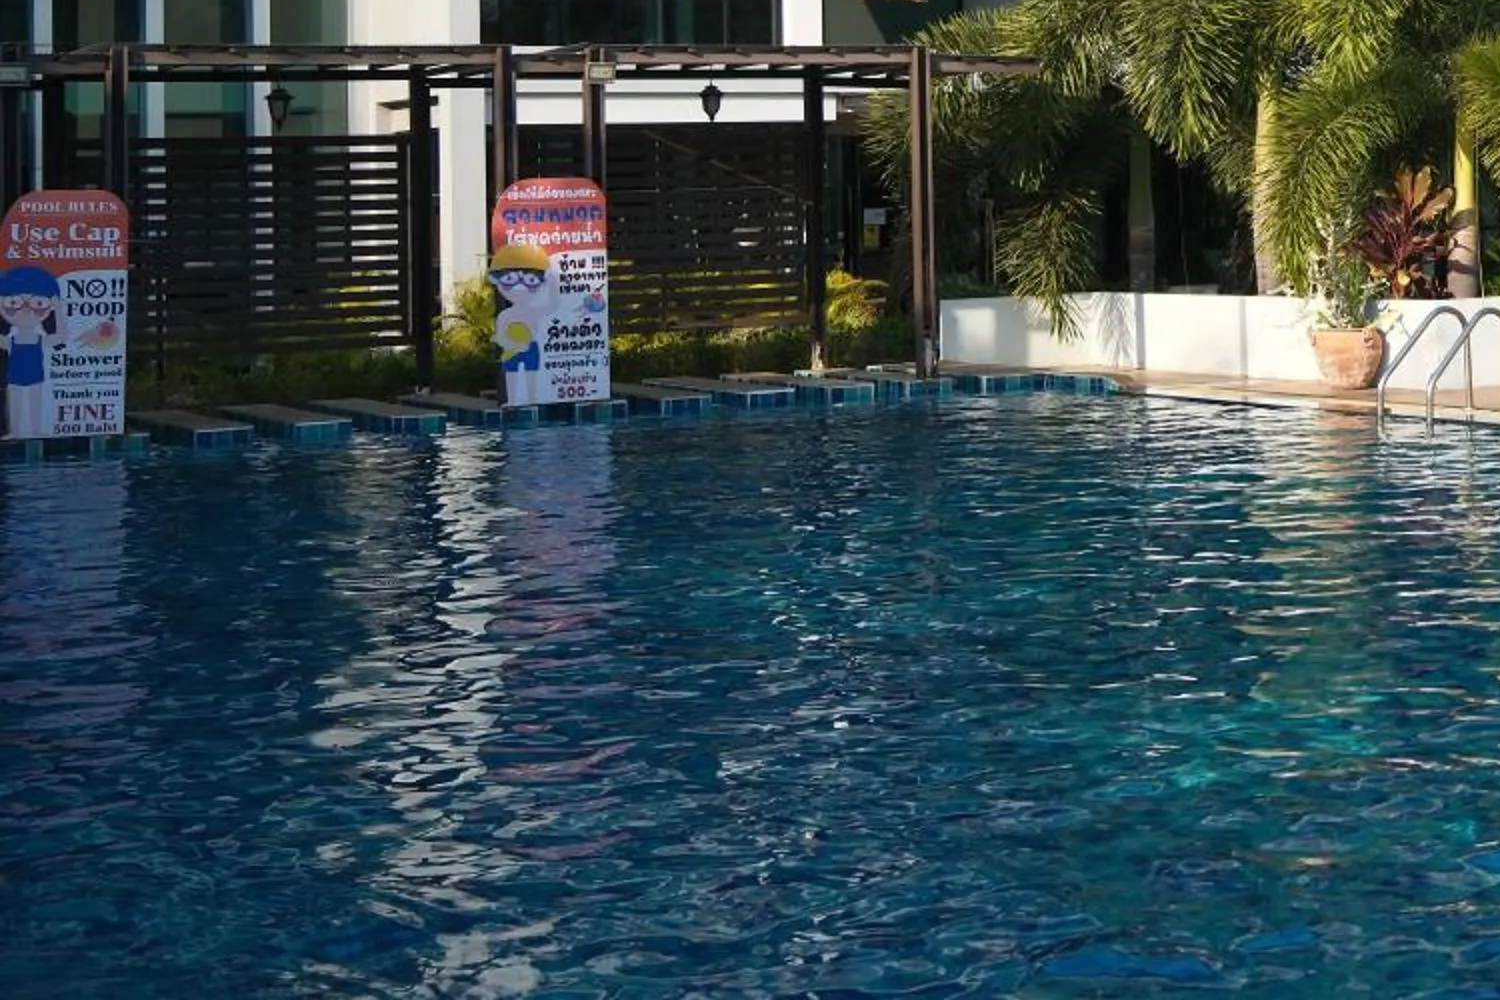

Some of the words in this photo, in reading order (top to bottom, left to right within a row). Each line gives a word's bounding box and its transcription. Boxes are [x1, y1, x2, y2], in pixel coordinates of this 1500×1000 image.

[20, 201, 65, 213] POOL
[69, 201, 118, 214] RULES
[11, 223, 60, 242] Use
[68, 223, 121, 246] Cap
[6, 245, 21, 259] &
[28, 243, 123, 259] Swimsuit
[66, 301, 125, 317] FOOD
[50, 353, 123, 367] Shower
[49, 371, 91, 380] before
[94, 368, 122, 379] pool
[52, 388, 93, 400] Thank
[95, 389, 119, 400] you
[57, 403, 116, 422] FINE
[52, 422, 81, 434] 500
[84, 422, 118, 433] Baht
